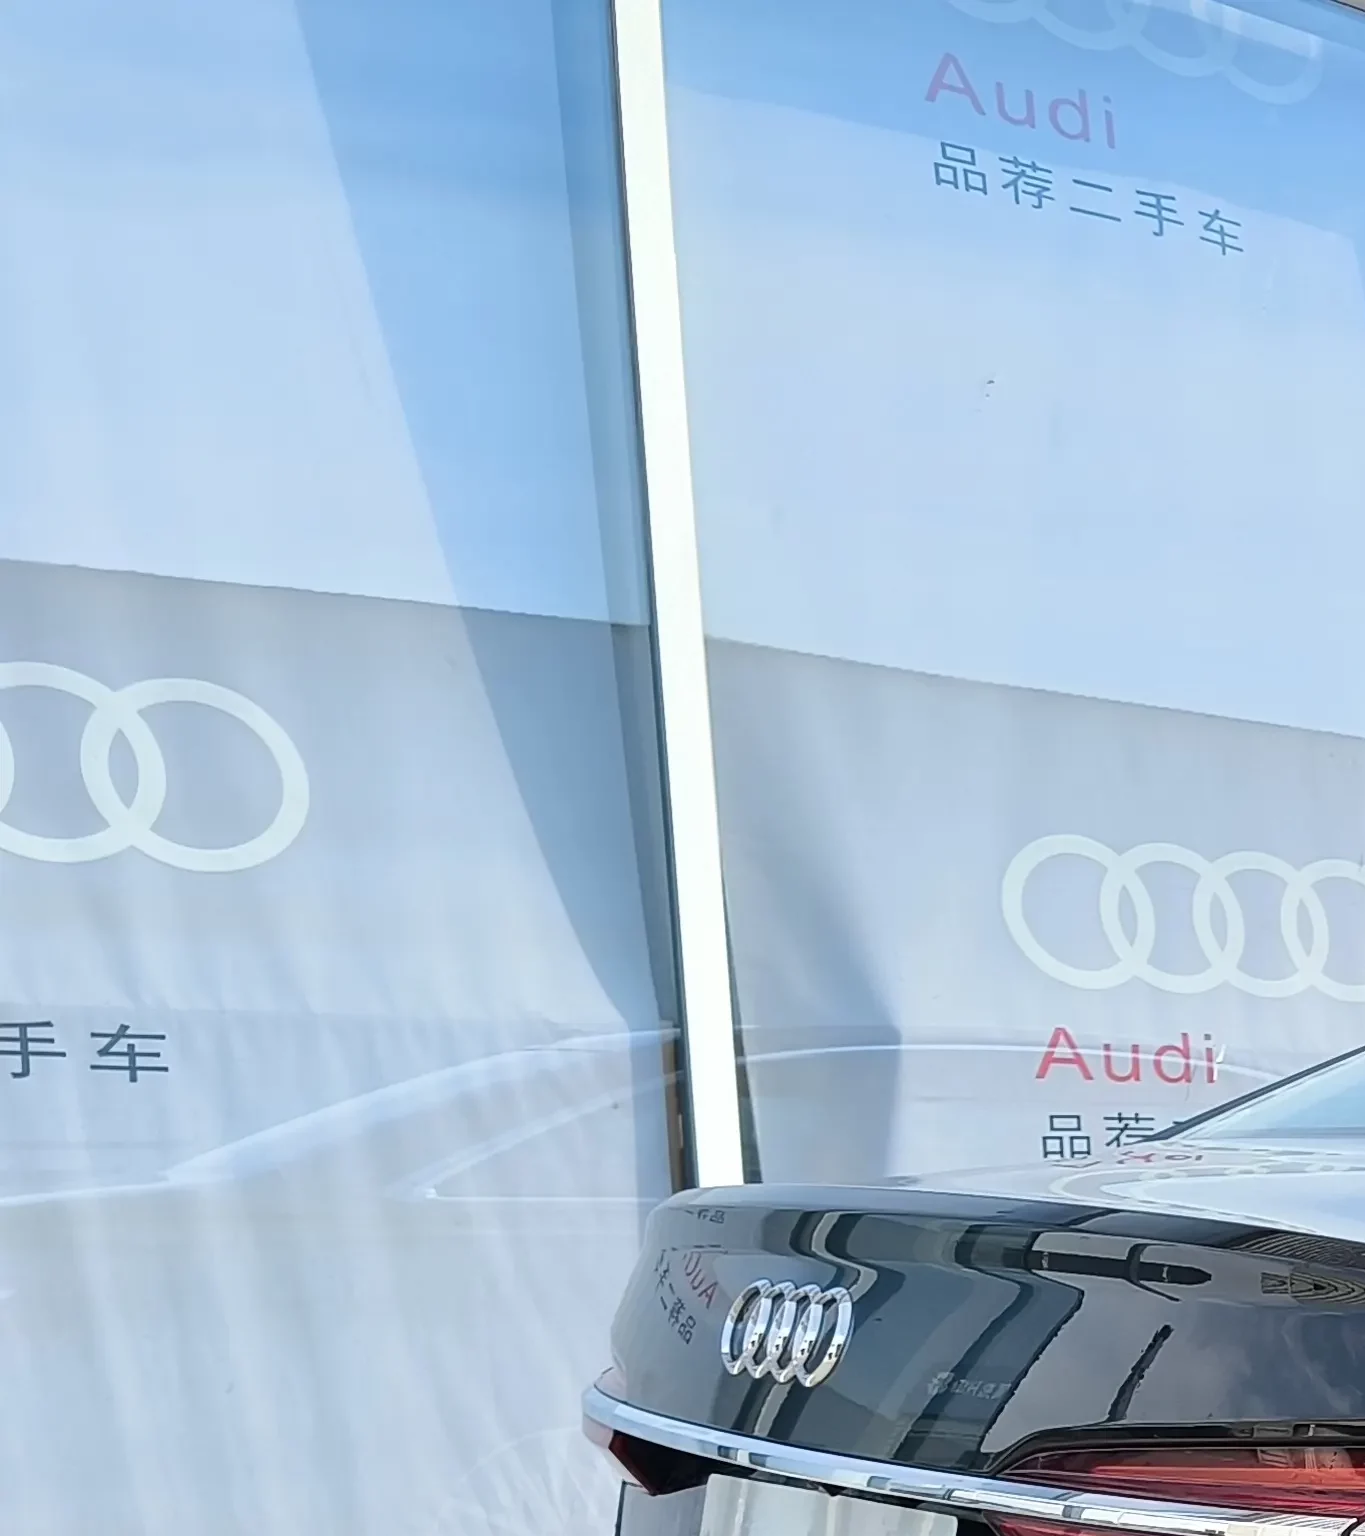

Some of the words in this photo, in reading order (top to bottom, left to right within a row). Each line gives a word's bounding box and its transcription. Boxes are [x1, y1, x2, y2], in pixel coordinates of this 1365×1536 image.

[925, 52, 1117, 149] Audi
[933, 141, 1244, 256] 品荐二手车
[0, 1020, 169, 1083] 手车
[1035, 1026, 1217, 1084] Audi
[1042, 1112, 1188, 1159] 品荐
